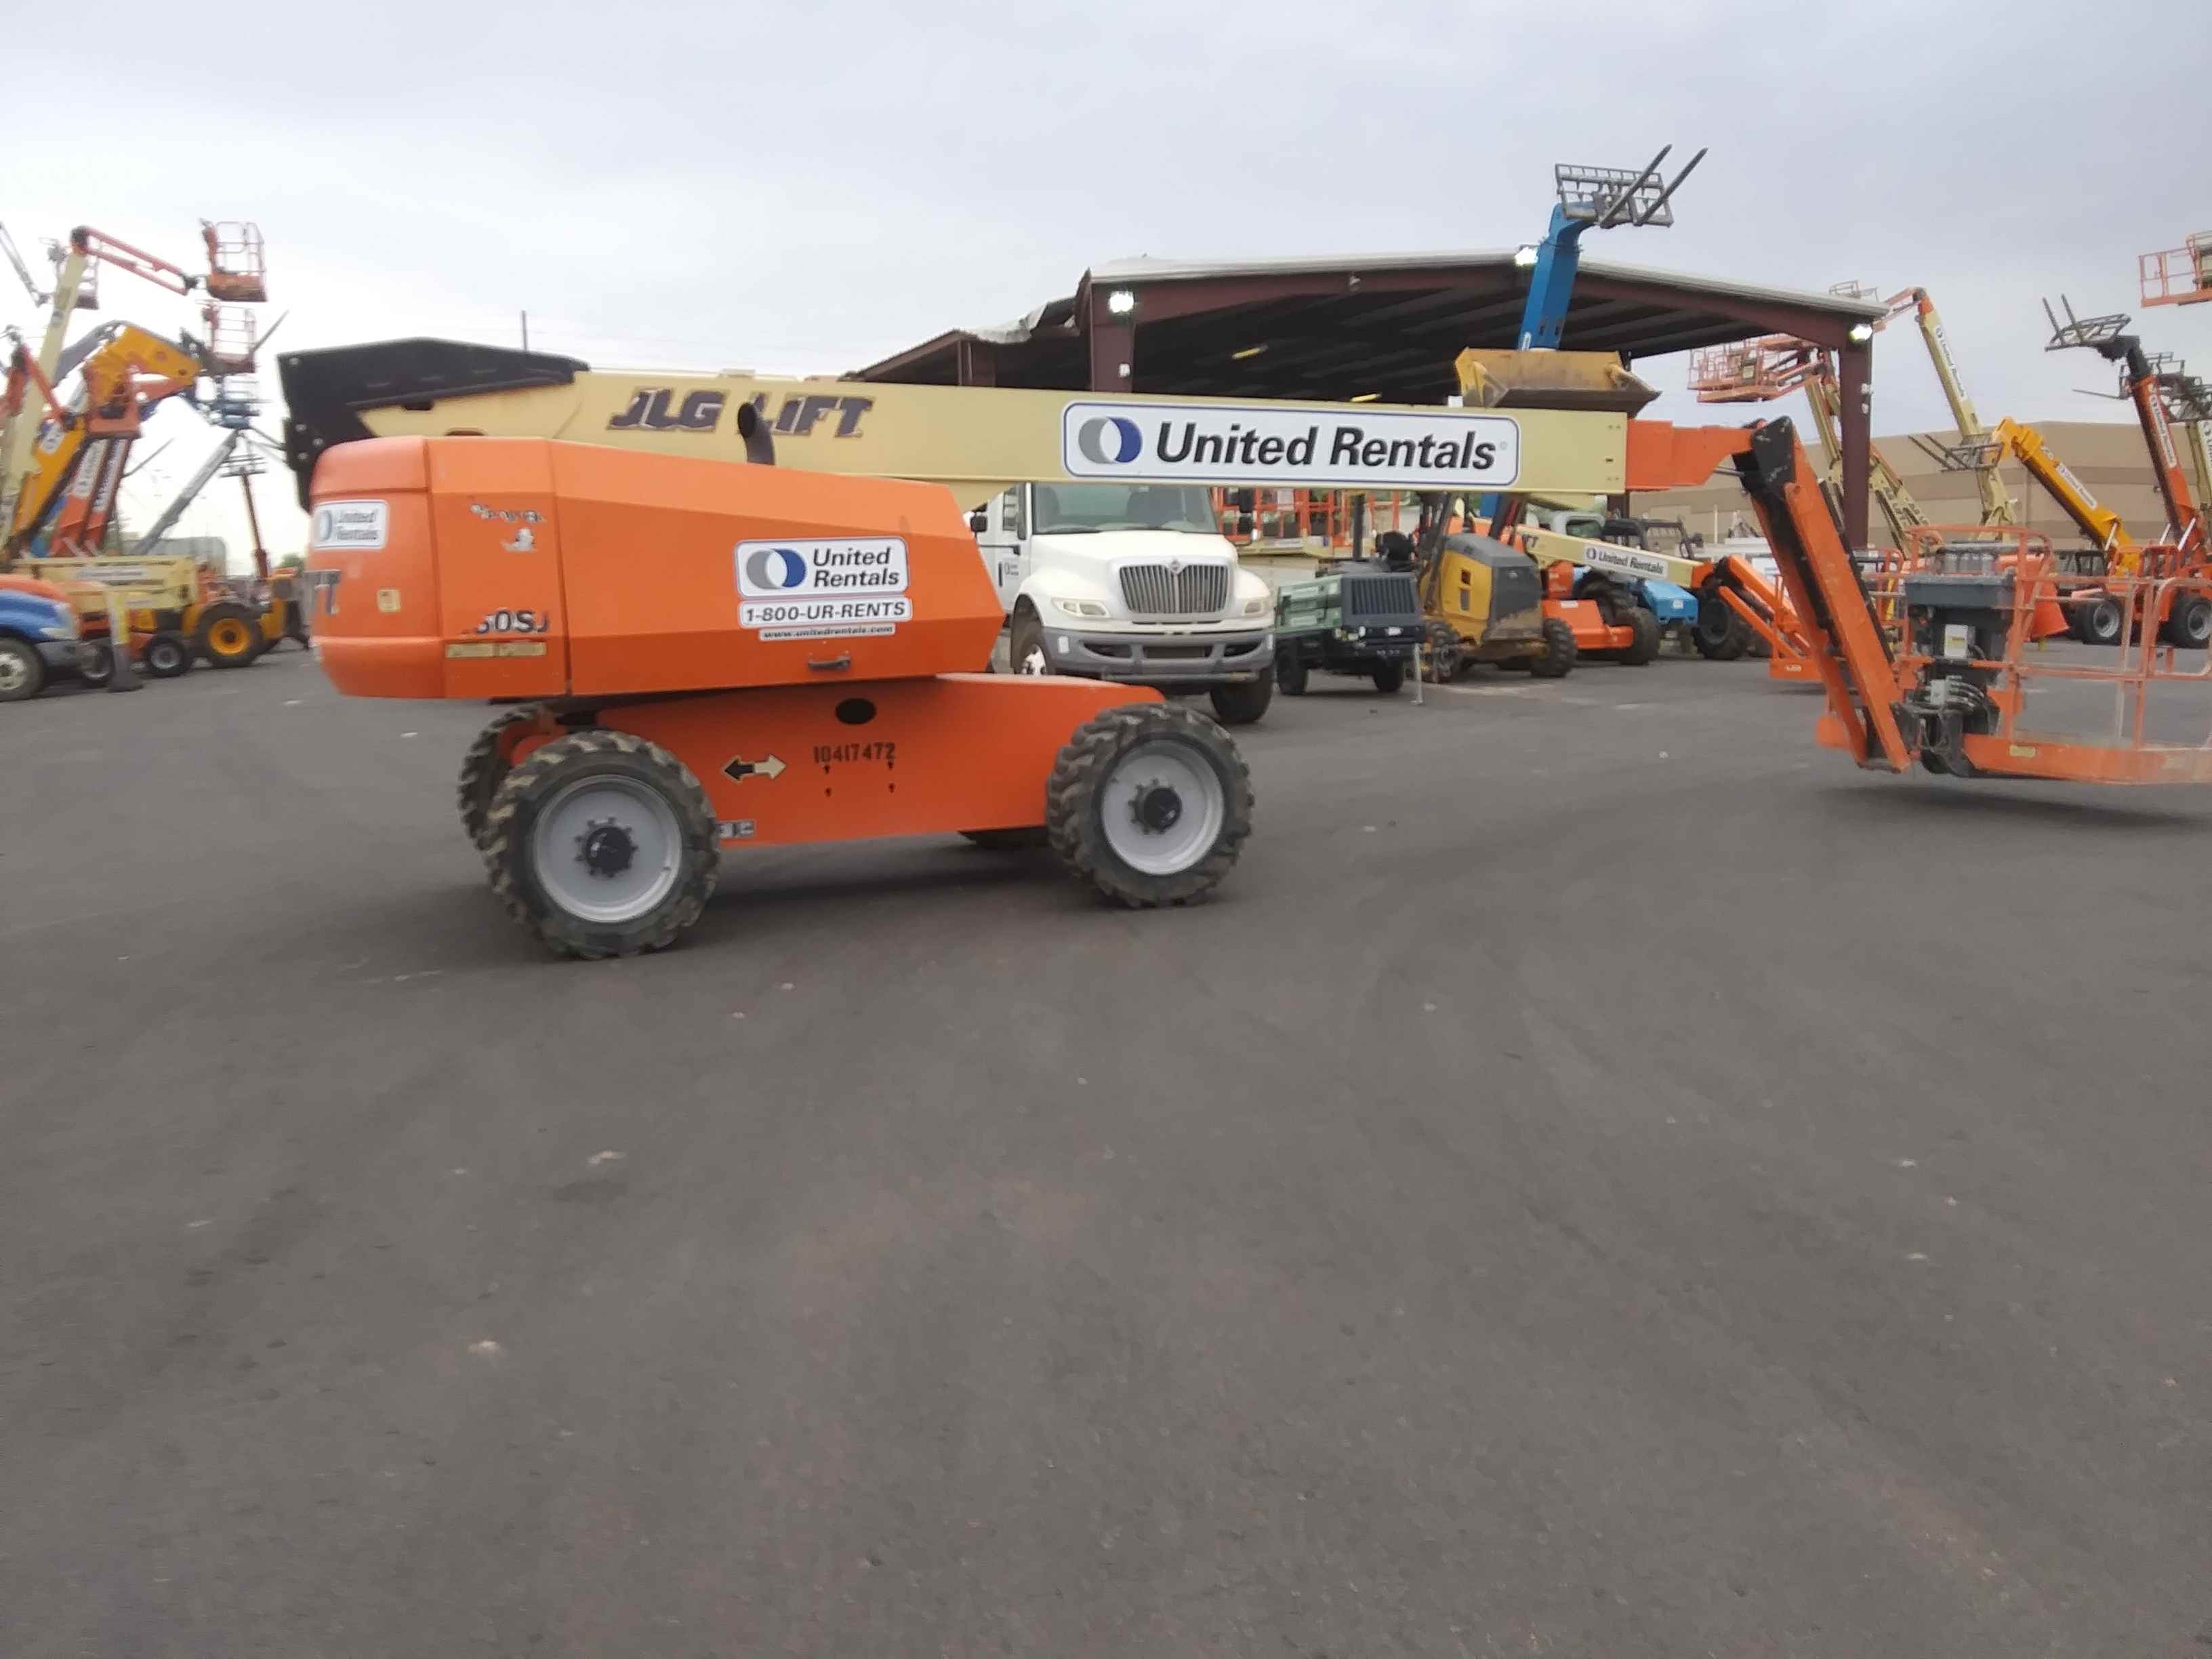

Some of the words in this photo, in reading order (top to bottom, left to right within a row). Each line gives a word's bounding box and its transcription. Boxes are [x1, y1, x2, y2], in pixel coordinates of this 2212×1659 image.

[608, 388, 729, 431] JLG
[1156, 422, 1318, 466] United
[1330, 426, 1496, 470] Rentals
[338, 510, 378, 524] United
[813, 546, 891, 567] United
[1598, 551, 1629, 567] United
[1629, 556, 1664, 574] Rentals
[814, 568, 900, 588] Rentals
[747, 601, 905, 622] 1-800-UR-RENTS
[813, 741, 896, 764] 10417472
